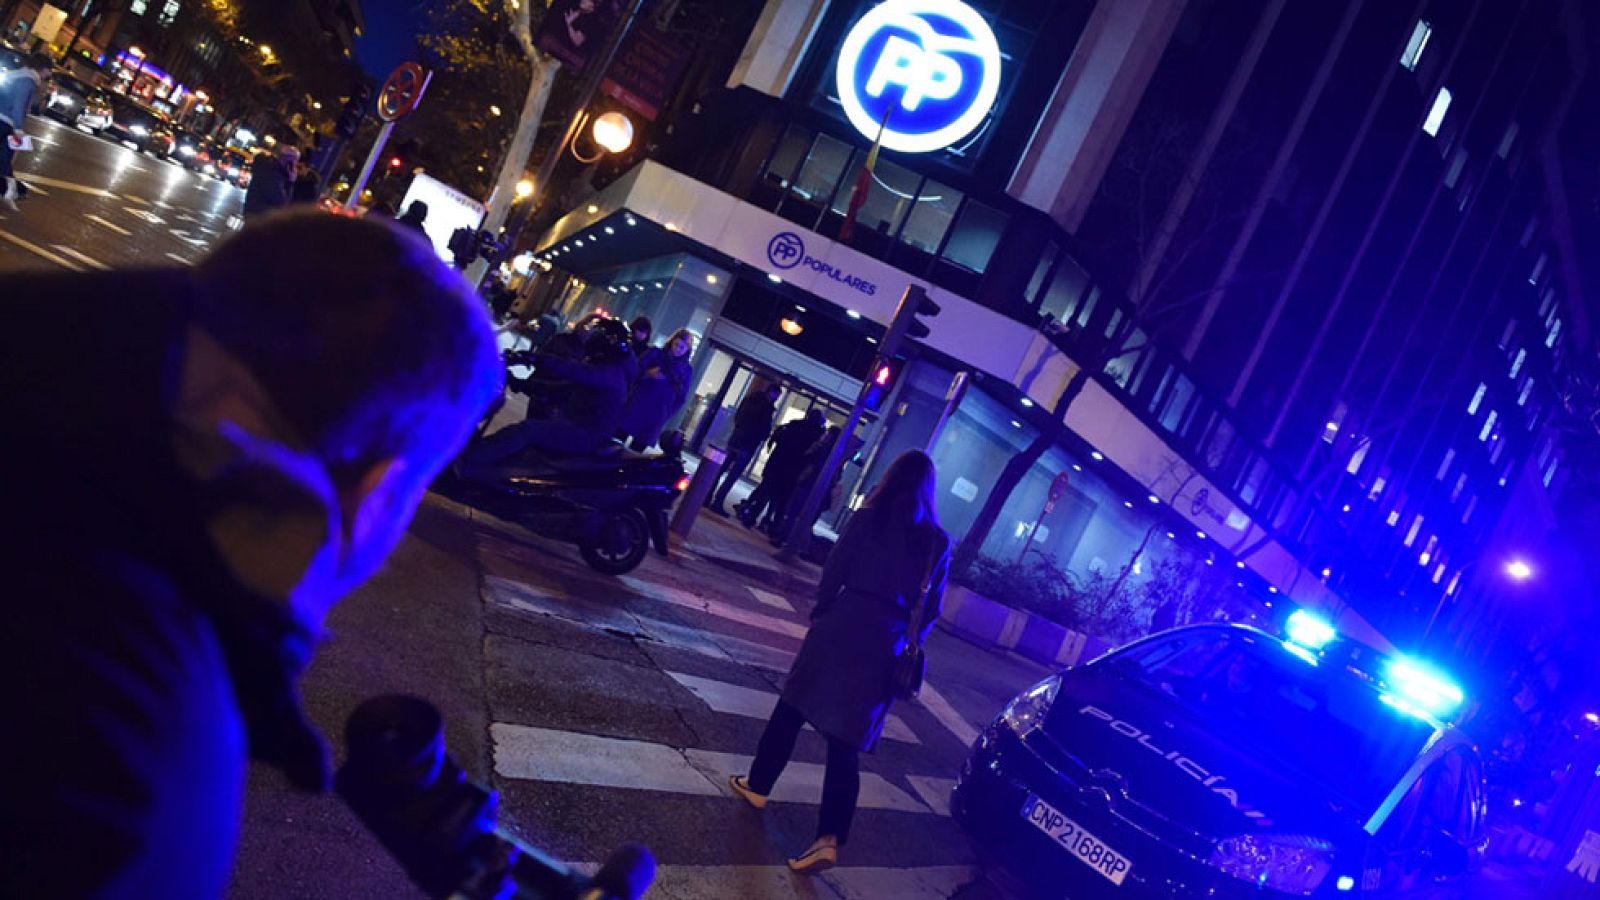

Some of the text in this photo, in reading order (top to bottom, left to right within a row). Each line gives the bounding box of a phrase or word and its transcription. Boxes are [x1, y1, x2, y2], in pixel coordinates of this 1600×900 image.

[865, 34, 963, 112] PP
[774, 242, 876, 296] PP POPULARES
[1031, 803, 1126, 876] CNP2168RP
